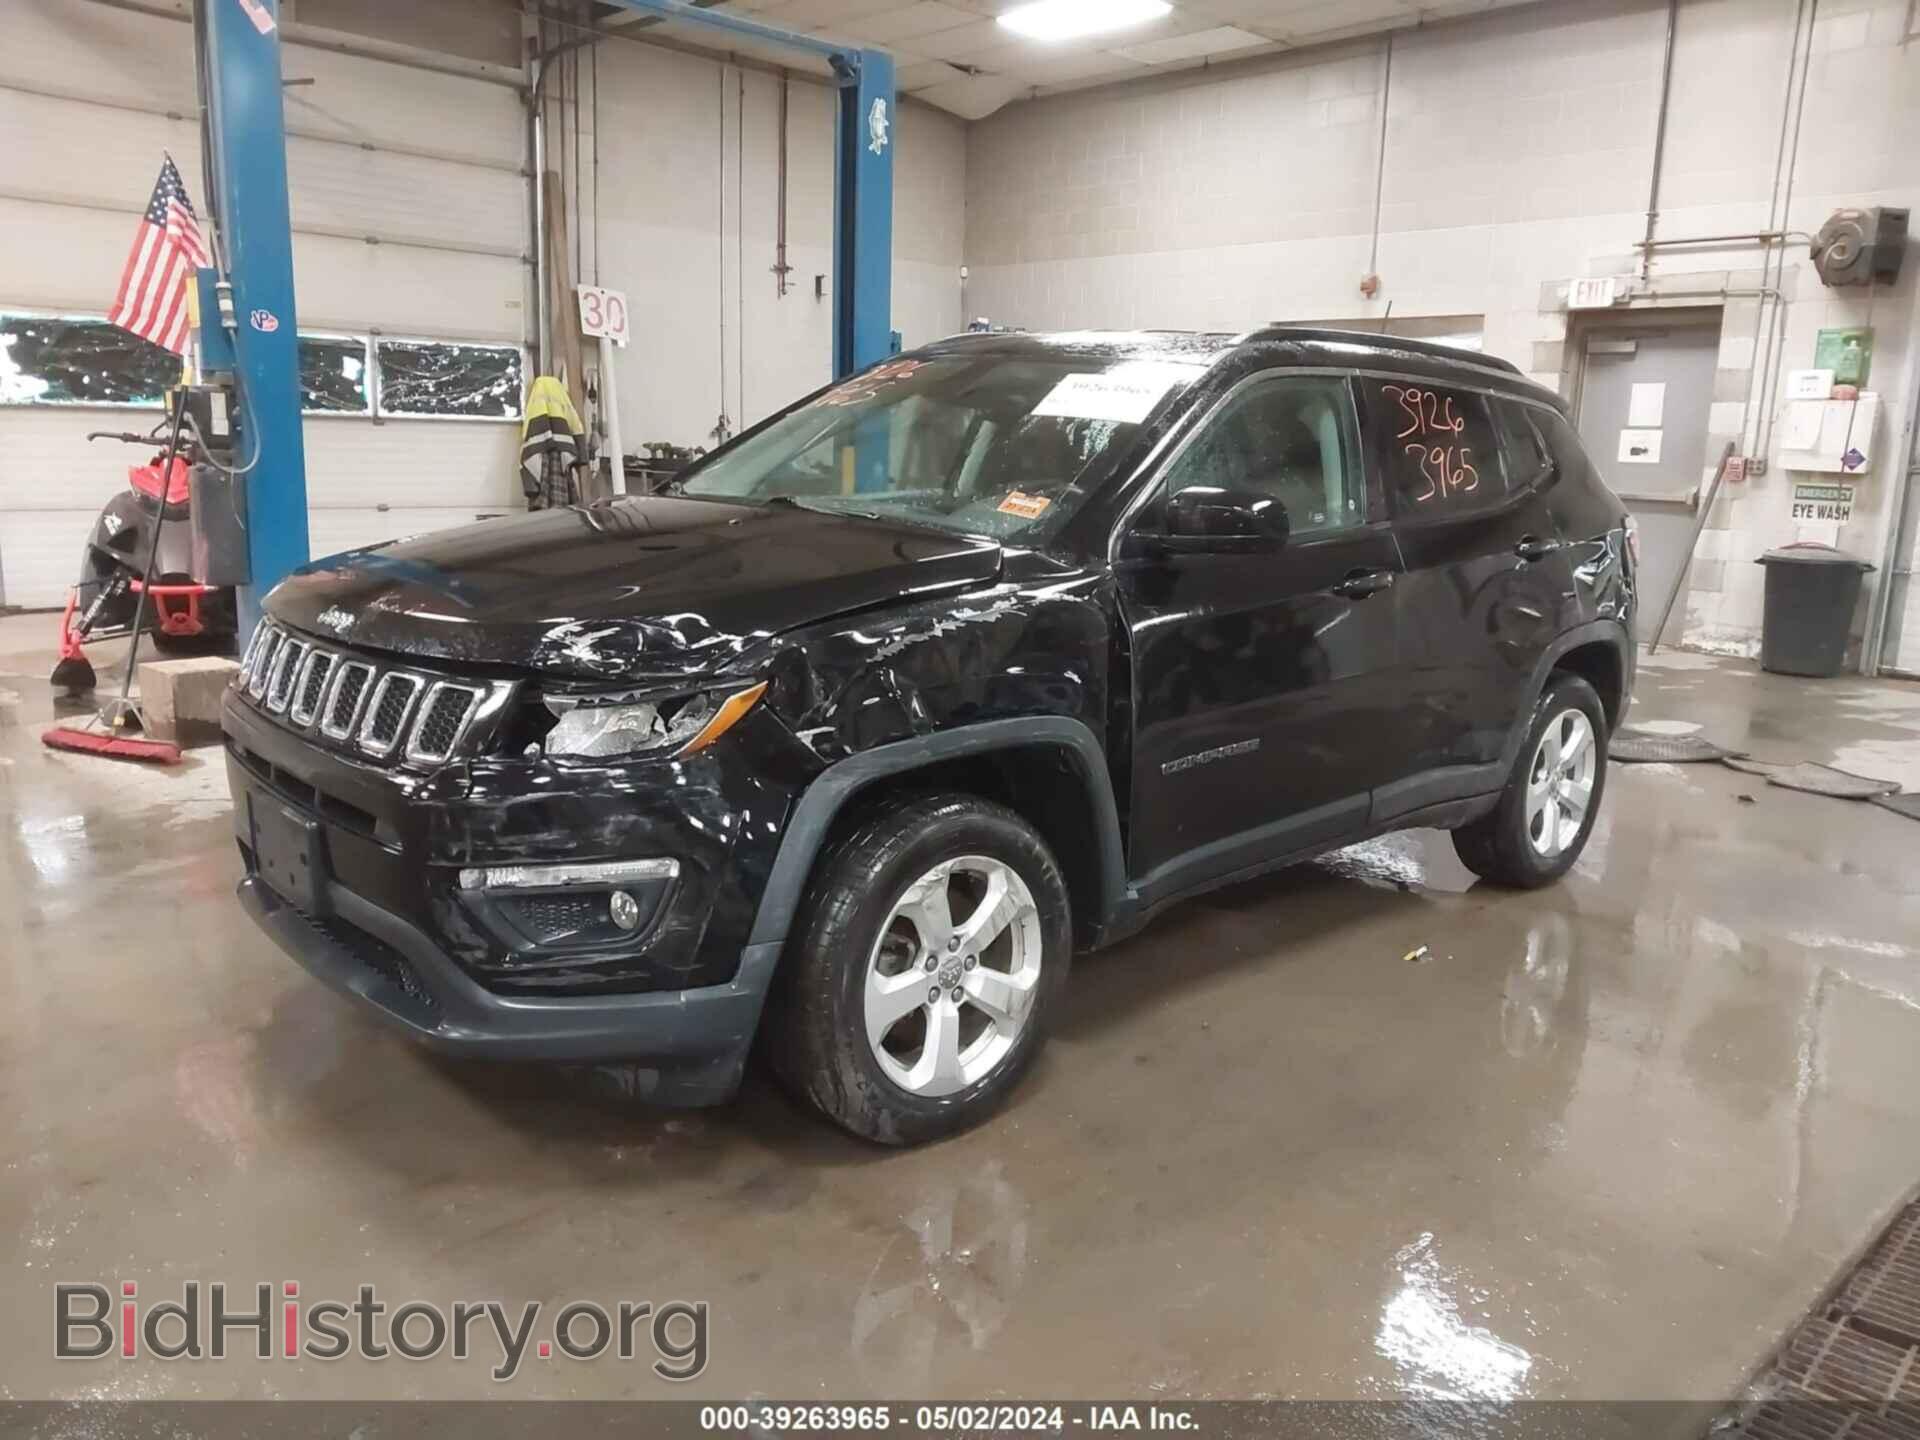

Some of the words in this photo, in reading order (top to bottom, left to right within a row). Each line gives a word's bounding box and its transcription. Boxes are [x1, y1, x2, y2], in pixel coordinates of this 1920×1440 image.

[583, 291, 625, 333] 30
[1577, 280, 1609, 305] EXIT
[1381, 385, 1465, 438] 3926
[1404, 443, 1479, 501] 3965
[1792, 503, 1814, 519] EYE
[1817, 504, 1851, 521] WASH
